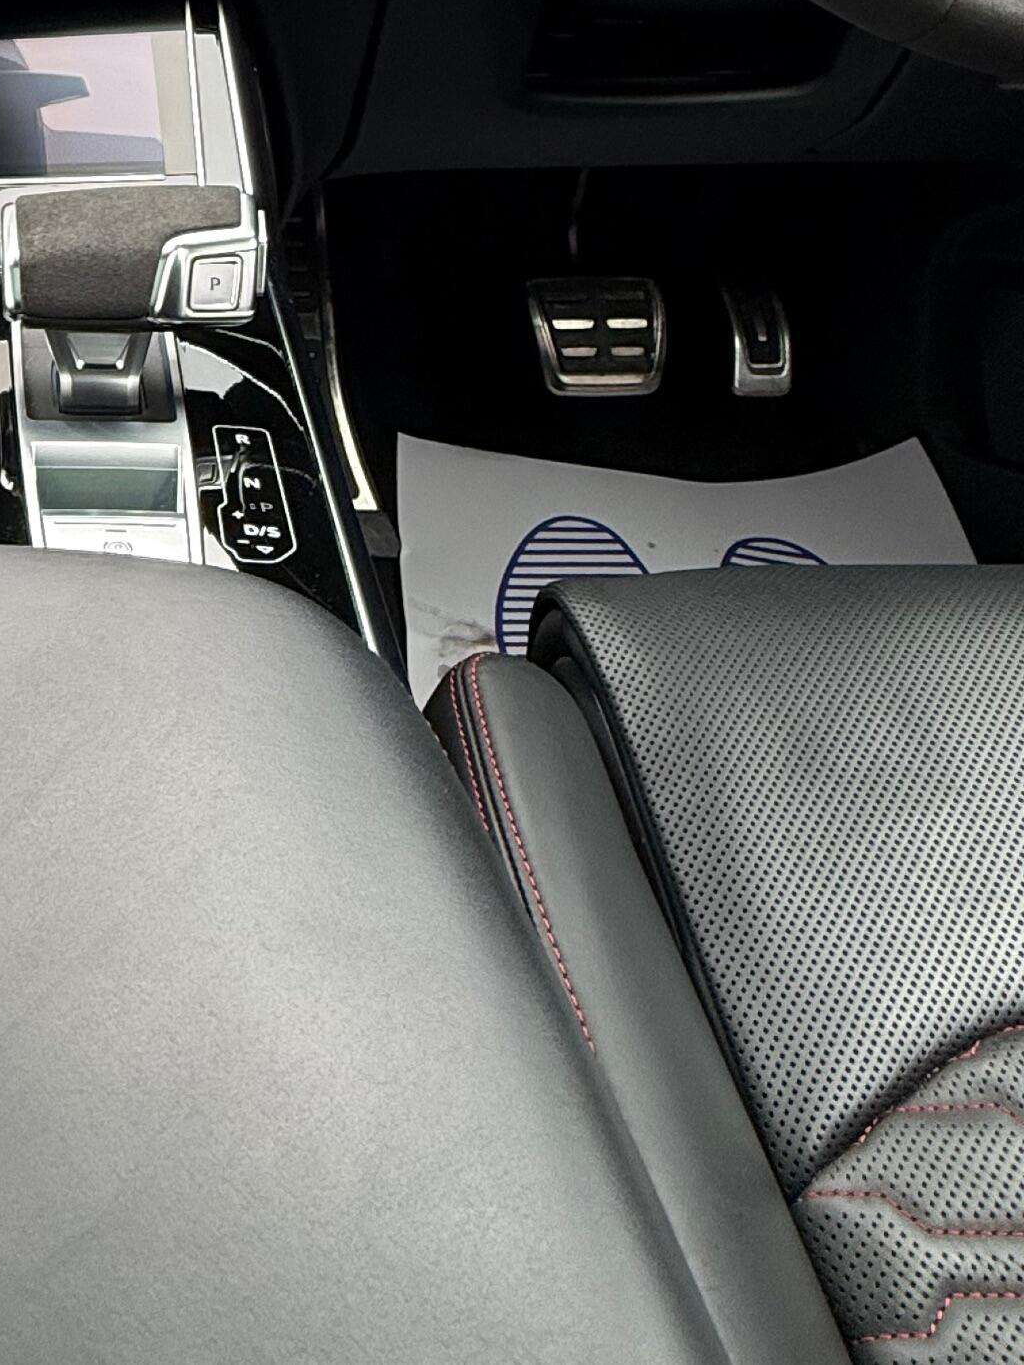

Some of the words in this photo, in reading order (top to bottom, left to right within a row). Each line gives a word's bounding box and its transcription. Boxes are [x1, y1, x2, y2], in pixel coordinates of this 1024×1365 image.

[209, 276, 221, 291] P
[235, 433, 251, 445] R
[243, 477, 261, 489] N
[243, 524, 281, 539] D/S
